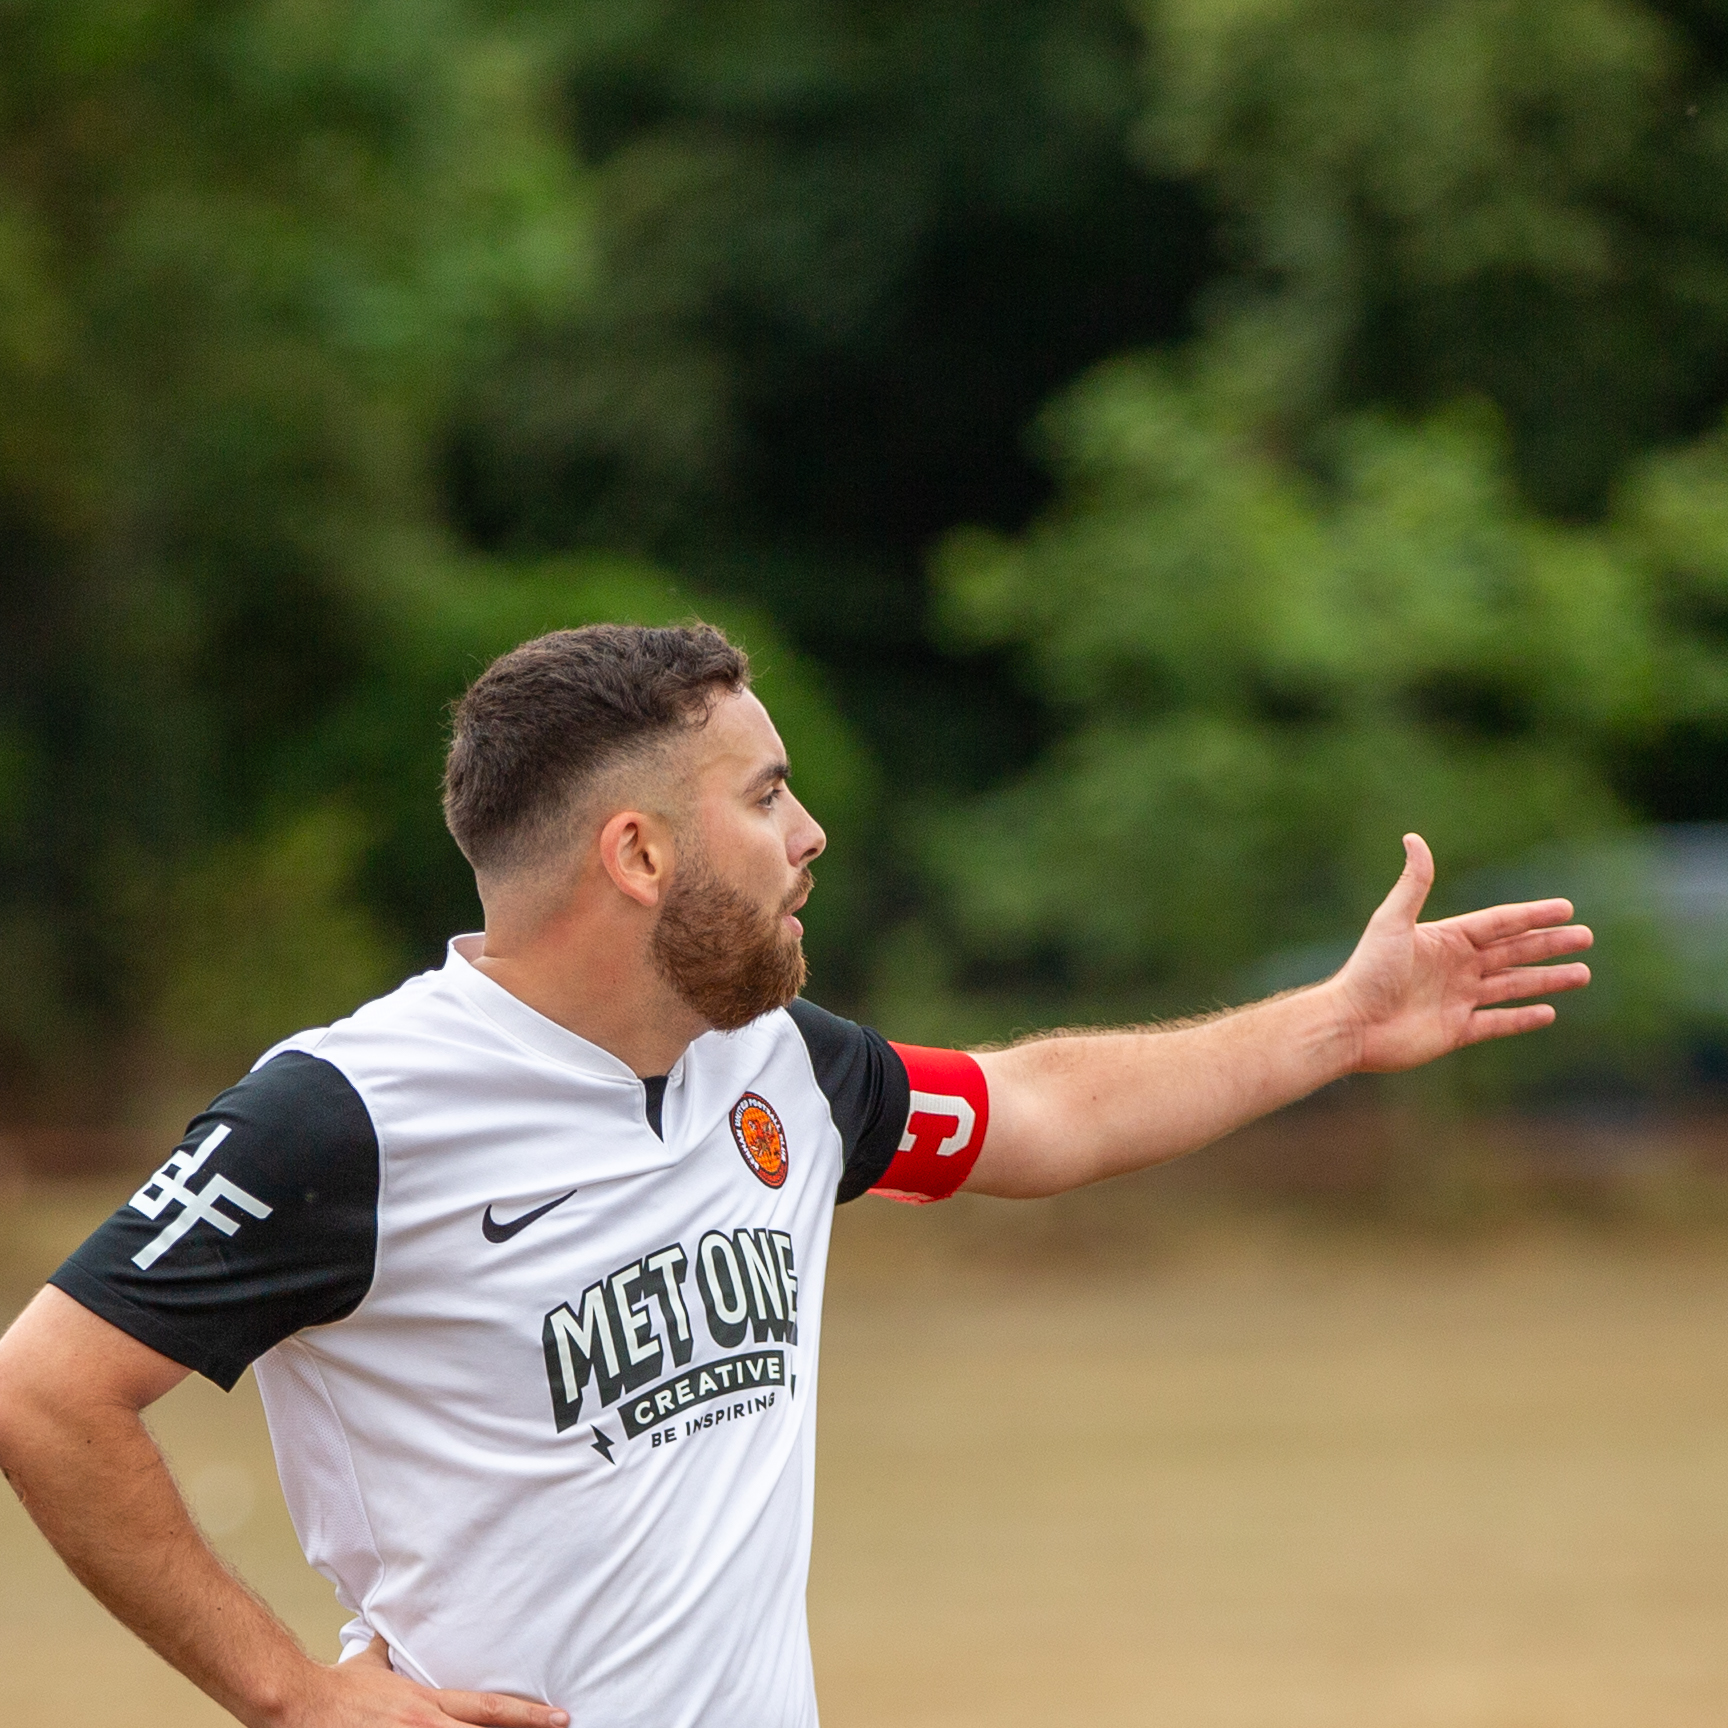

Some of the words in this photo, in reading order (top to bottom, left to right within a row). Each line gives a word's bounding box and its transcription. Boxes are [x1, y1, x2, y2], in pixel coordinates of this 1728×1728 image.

[897, 1090, 976, 1157] C
[542, 1242, 694, 1434] MET
[695, 1228, 799, 1348] ONE
[634, 1357, 781, 1425] CREATIVE
[651, 1426, 678, 1449] BE
[685, 1391, 776, 1437] INSPIRING
